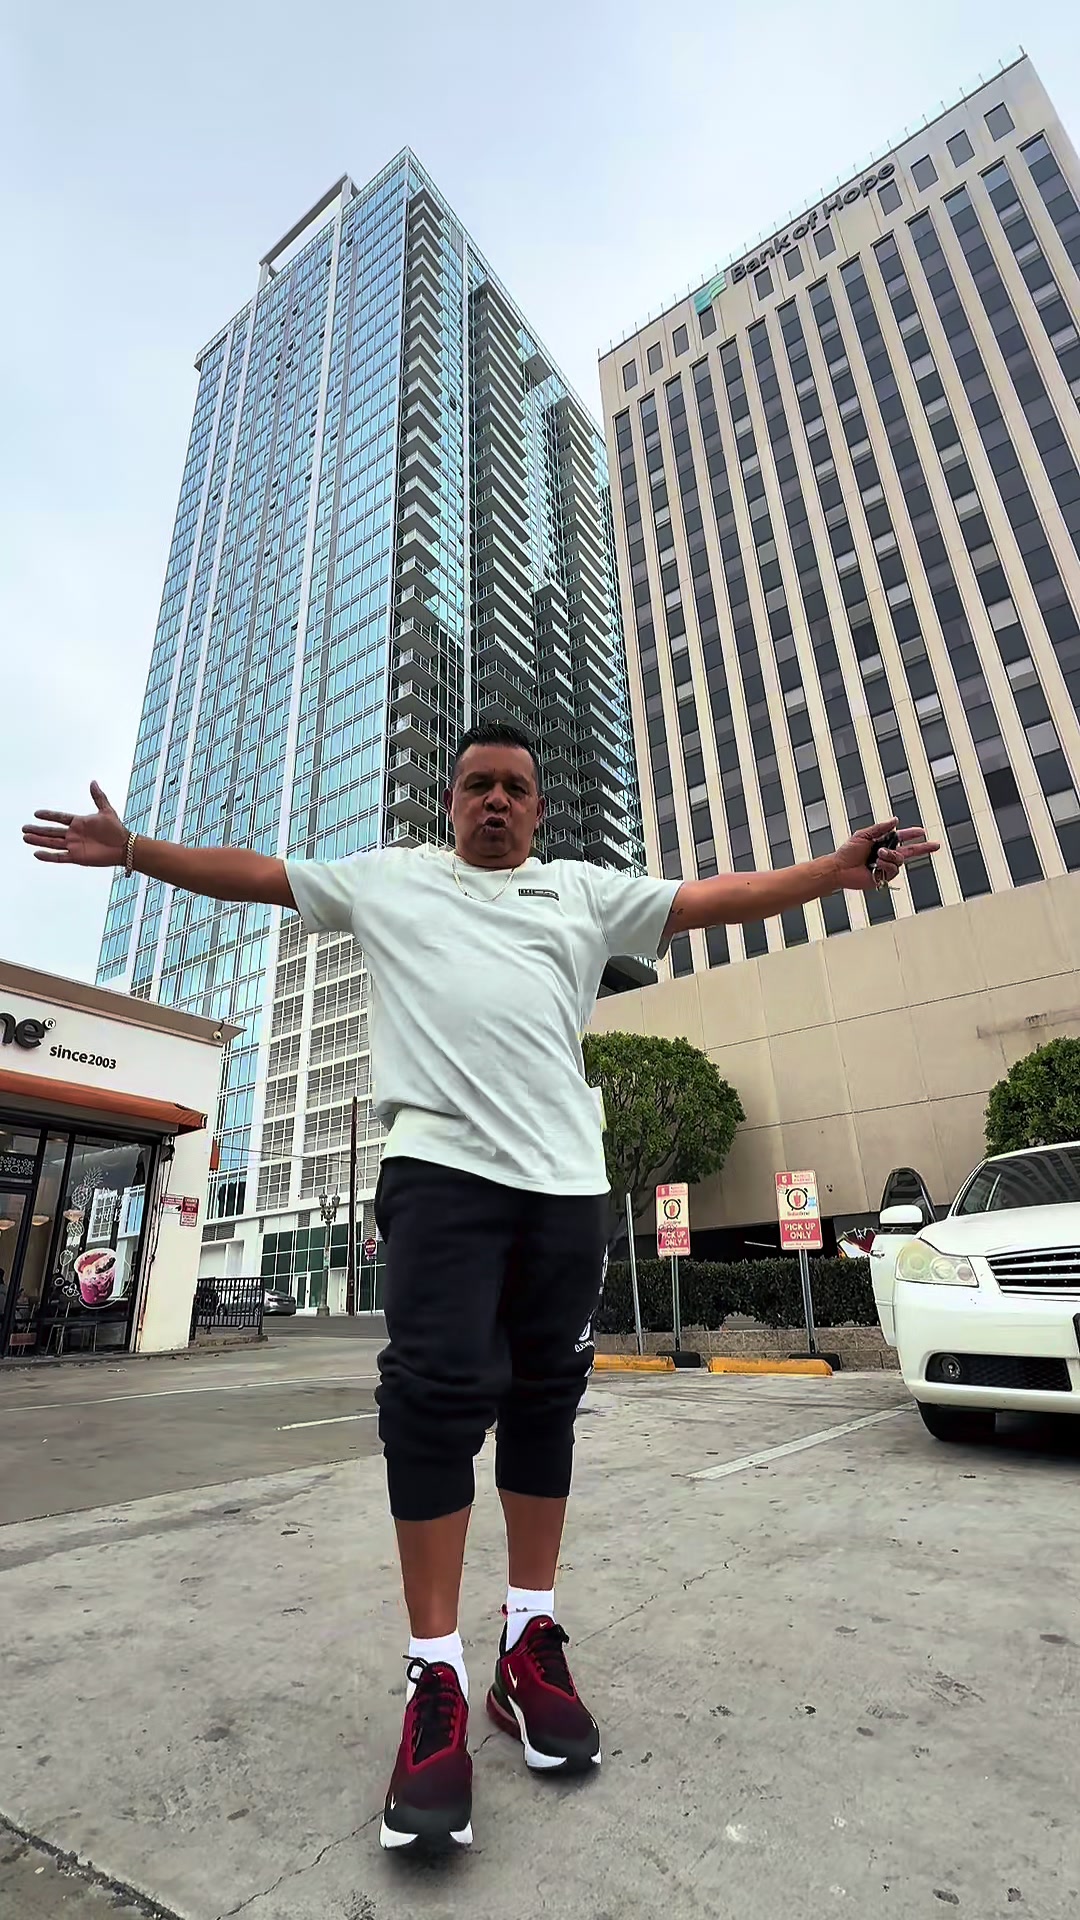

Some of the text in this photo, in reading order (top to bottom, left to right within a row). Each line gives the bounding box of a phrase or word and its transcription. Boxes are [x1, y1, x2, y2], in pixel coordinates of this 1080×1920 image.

[731, 162, 895, 284] Bank of Hope
[49, 1044, 117, 1070] since2003
[784, 1222, 816, 1231] PICK UP
[676, 1231, 686, 1239] UP
[790, 1231, 812, 1240] ONLY
[665, 1238, 682, 1247] ONLY
